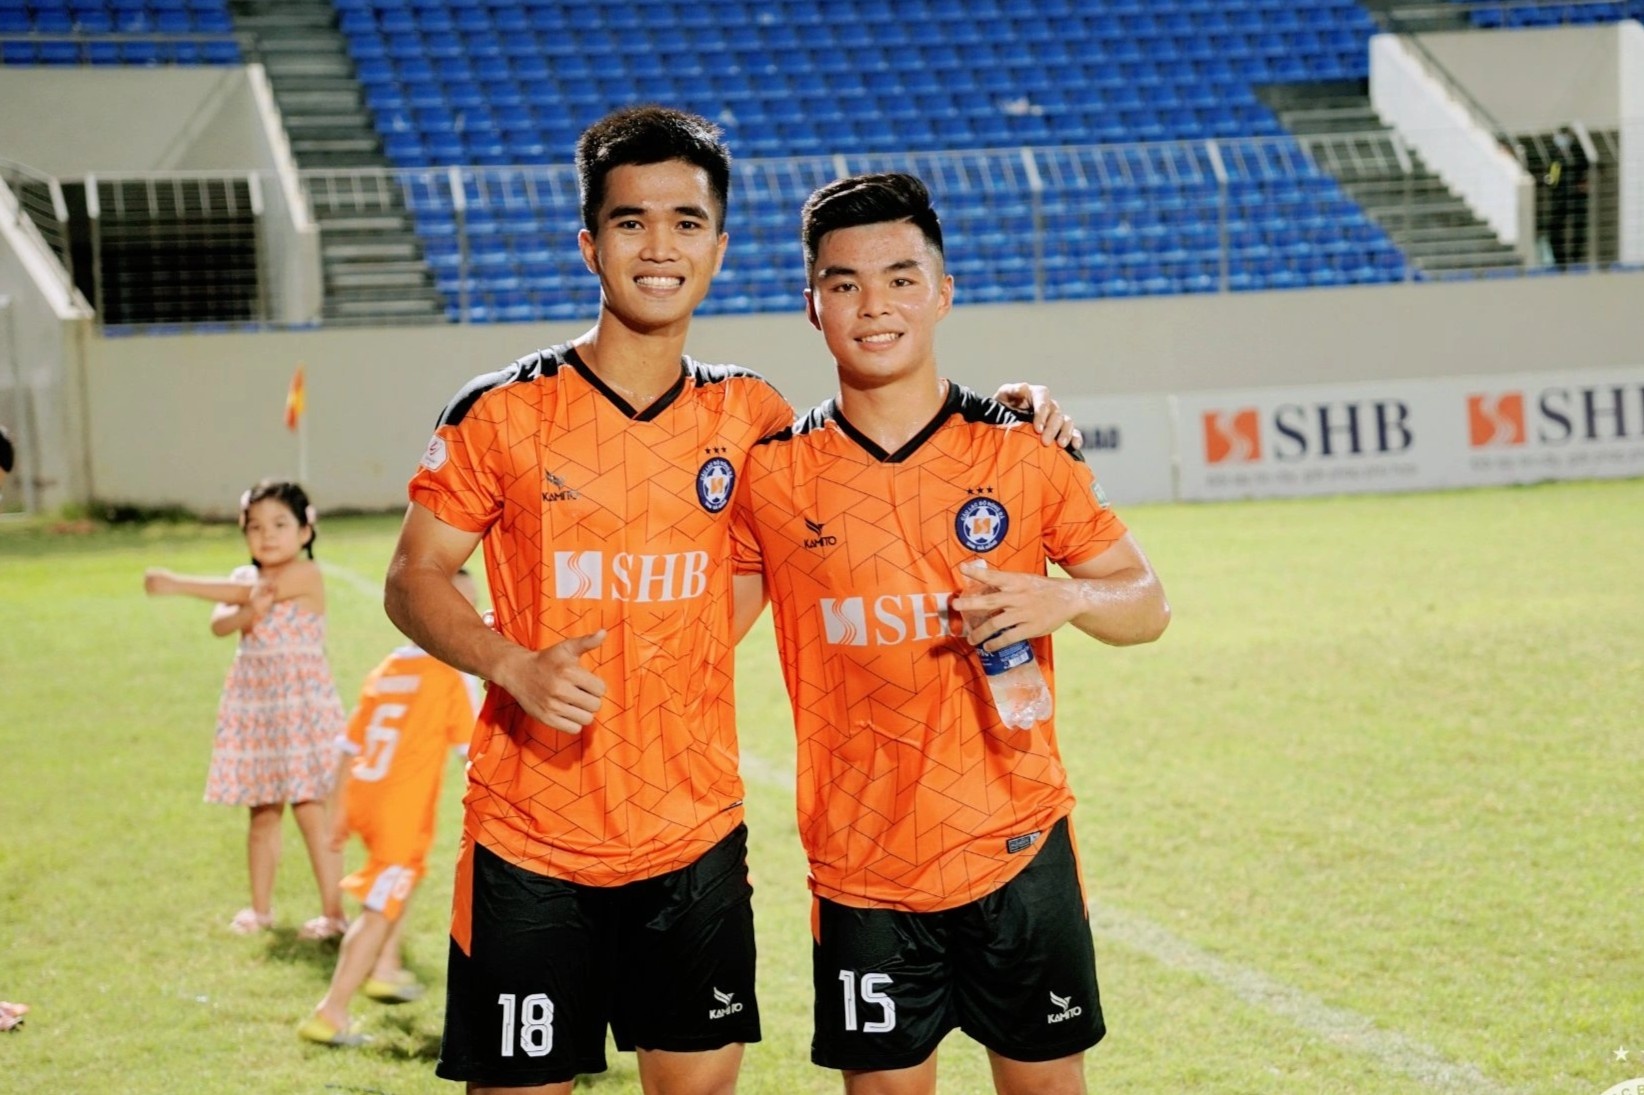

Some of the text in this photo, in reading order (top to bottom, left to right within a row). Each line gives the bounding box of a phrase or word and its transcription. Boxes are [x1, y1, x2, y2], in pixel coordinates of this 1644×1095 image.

[1273, 400, 1415, 463] SHB
[1538, 384, 1644, 446] SH
[804, 535, 838, 549] KAMITO
[611, 550, 709, 603] SHB
[874, 592, 968, 646] SH
[498, 993, 554, 1057] 18
[709, 1002, 743, 1019] KAMITO
[838, 969, 896, 1033] 15
[1047, 1006, 1082, 1024] KAMITO
